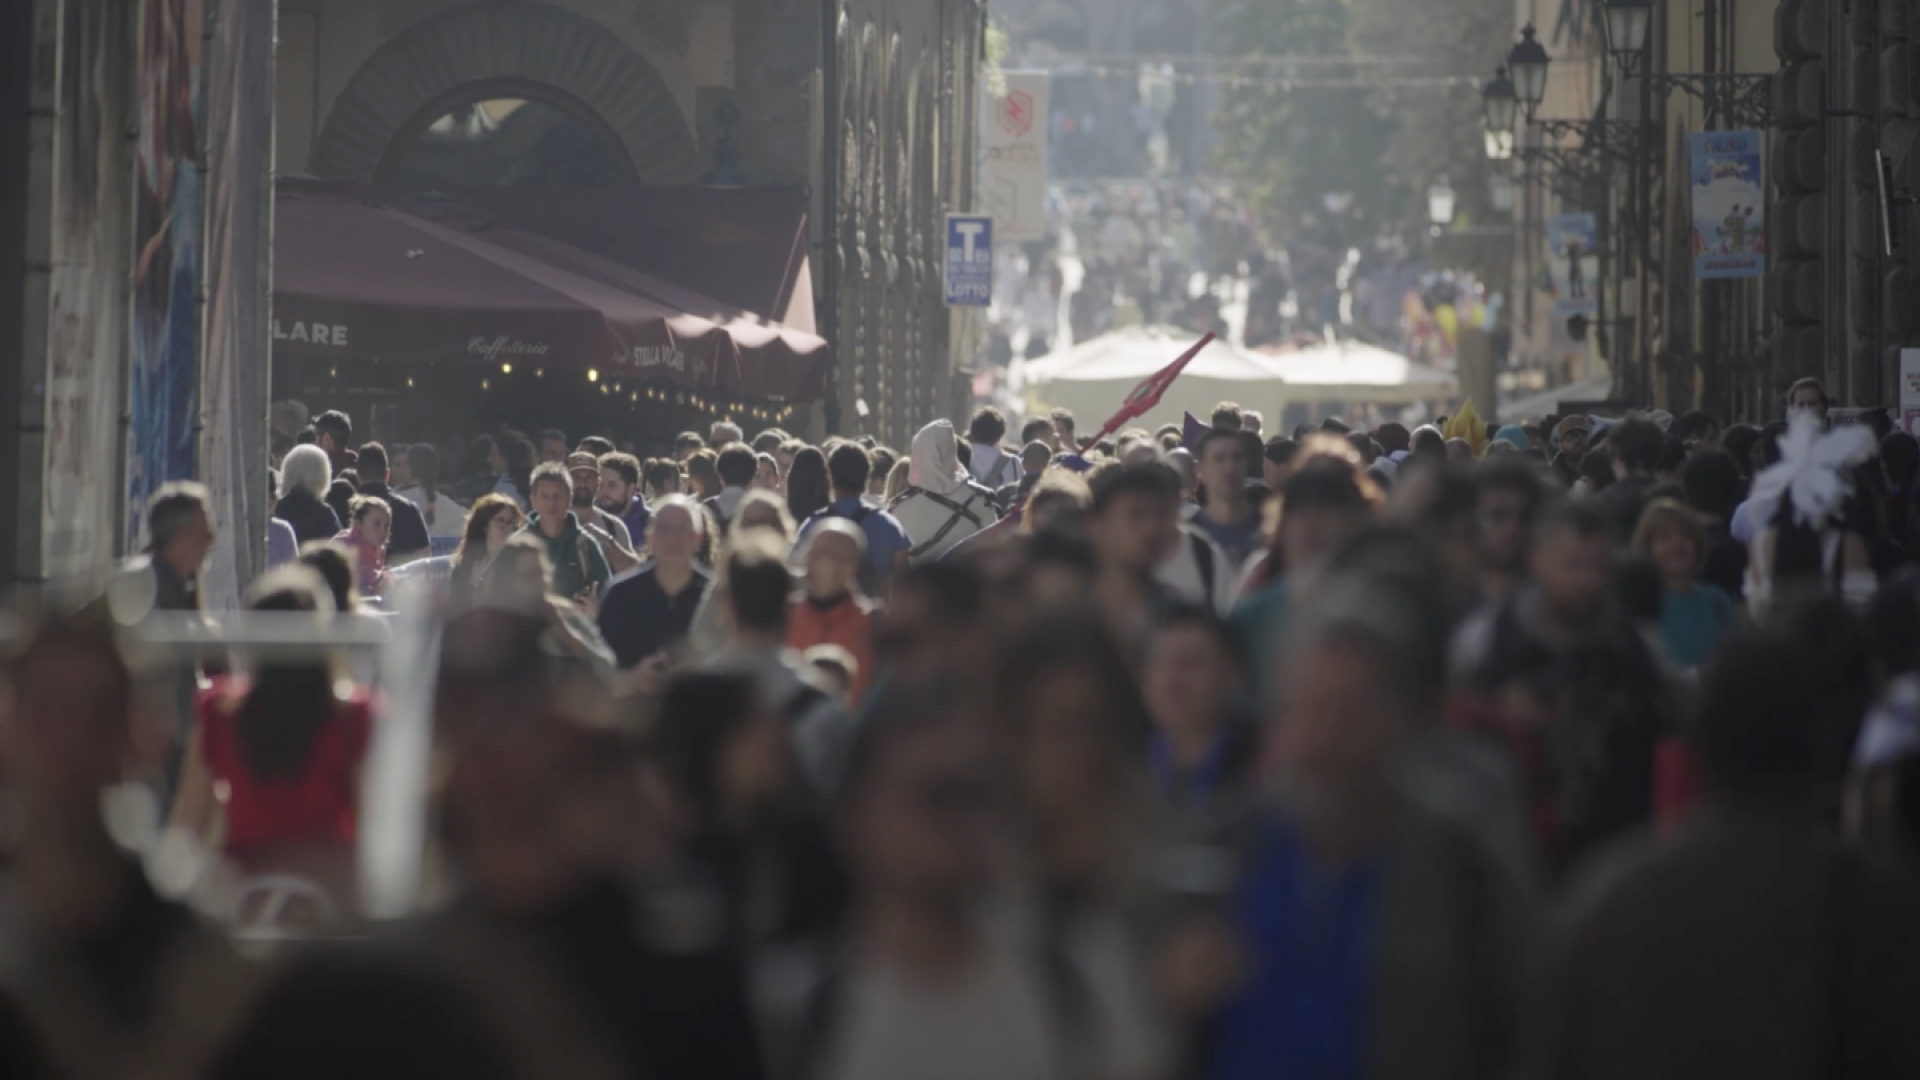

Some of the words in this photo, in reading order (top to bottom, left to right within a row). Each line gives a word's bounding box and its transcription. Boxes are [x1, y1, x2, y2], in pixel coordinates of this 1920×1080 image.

[955, 222, 984, 262] T
[948, 282, 988, 299] LOTTO
[634, 345, 660, 367] STELLA
